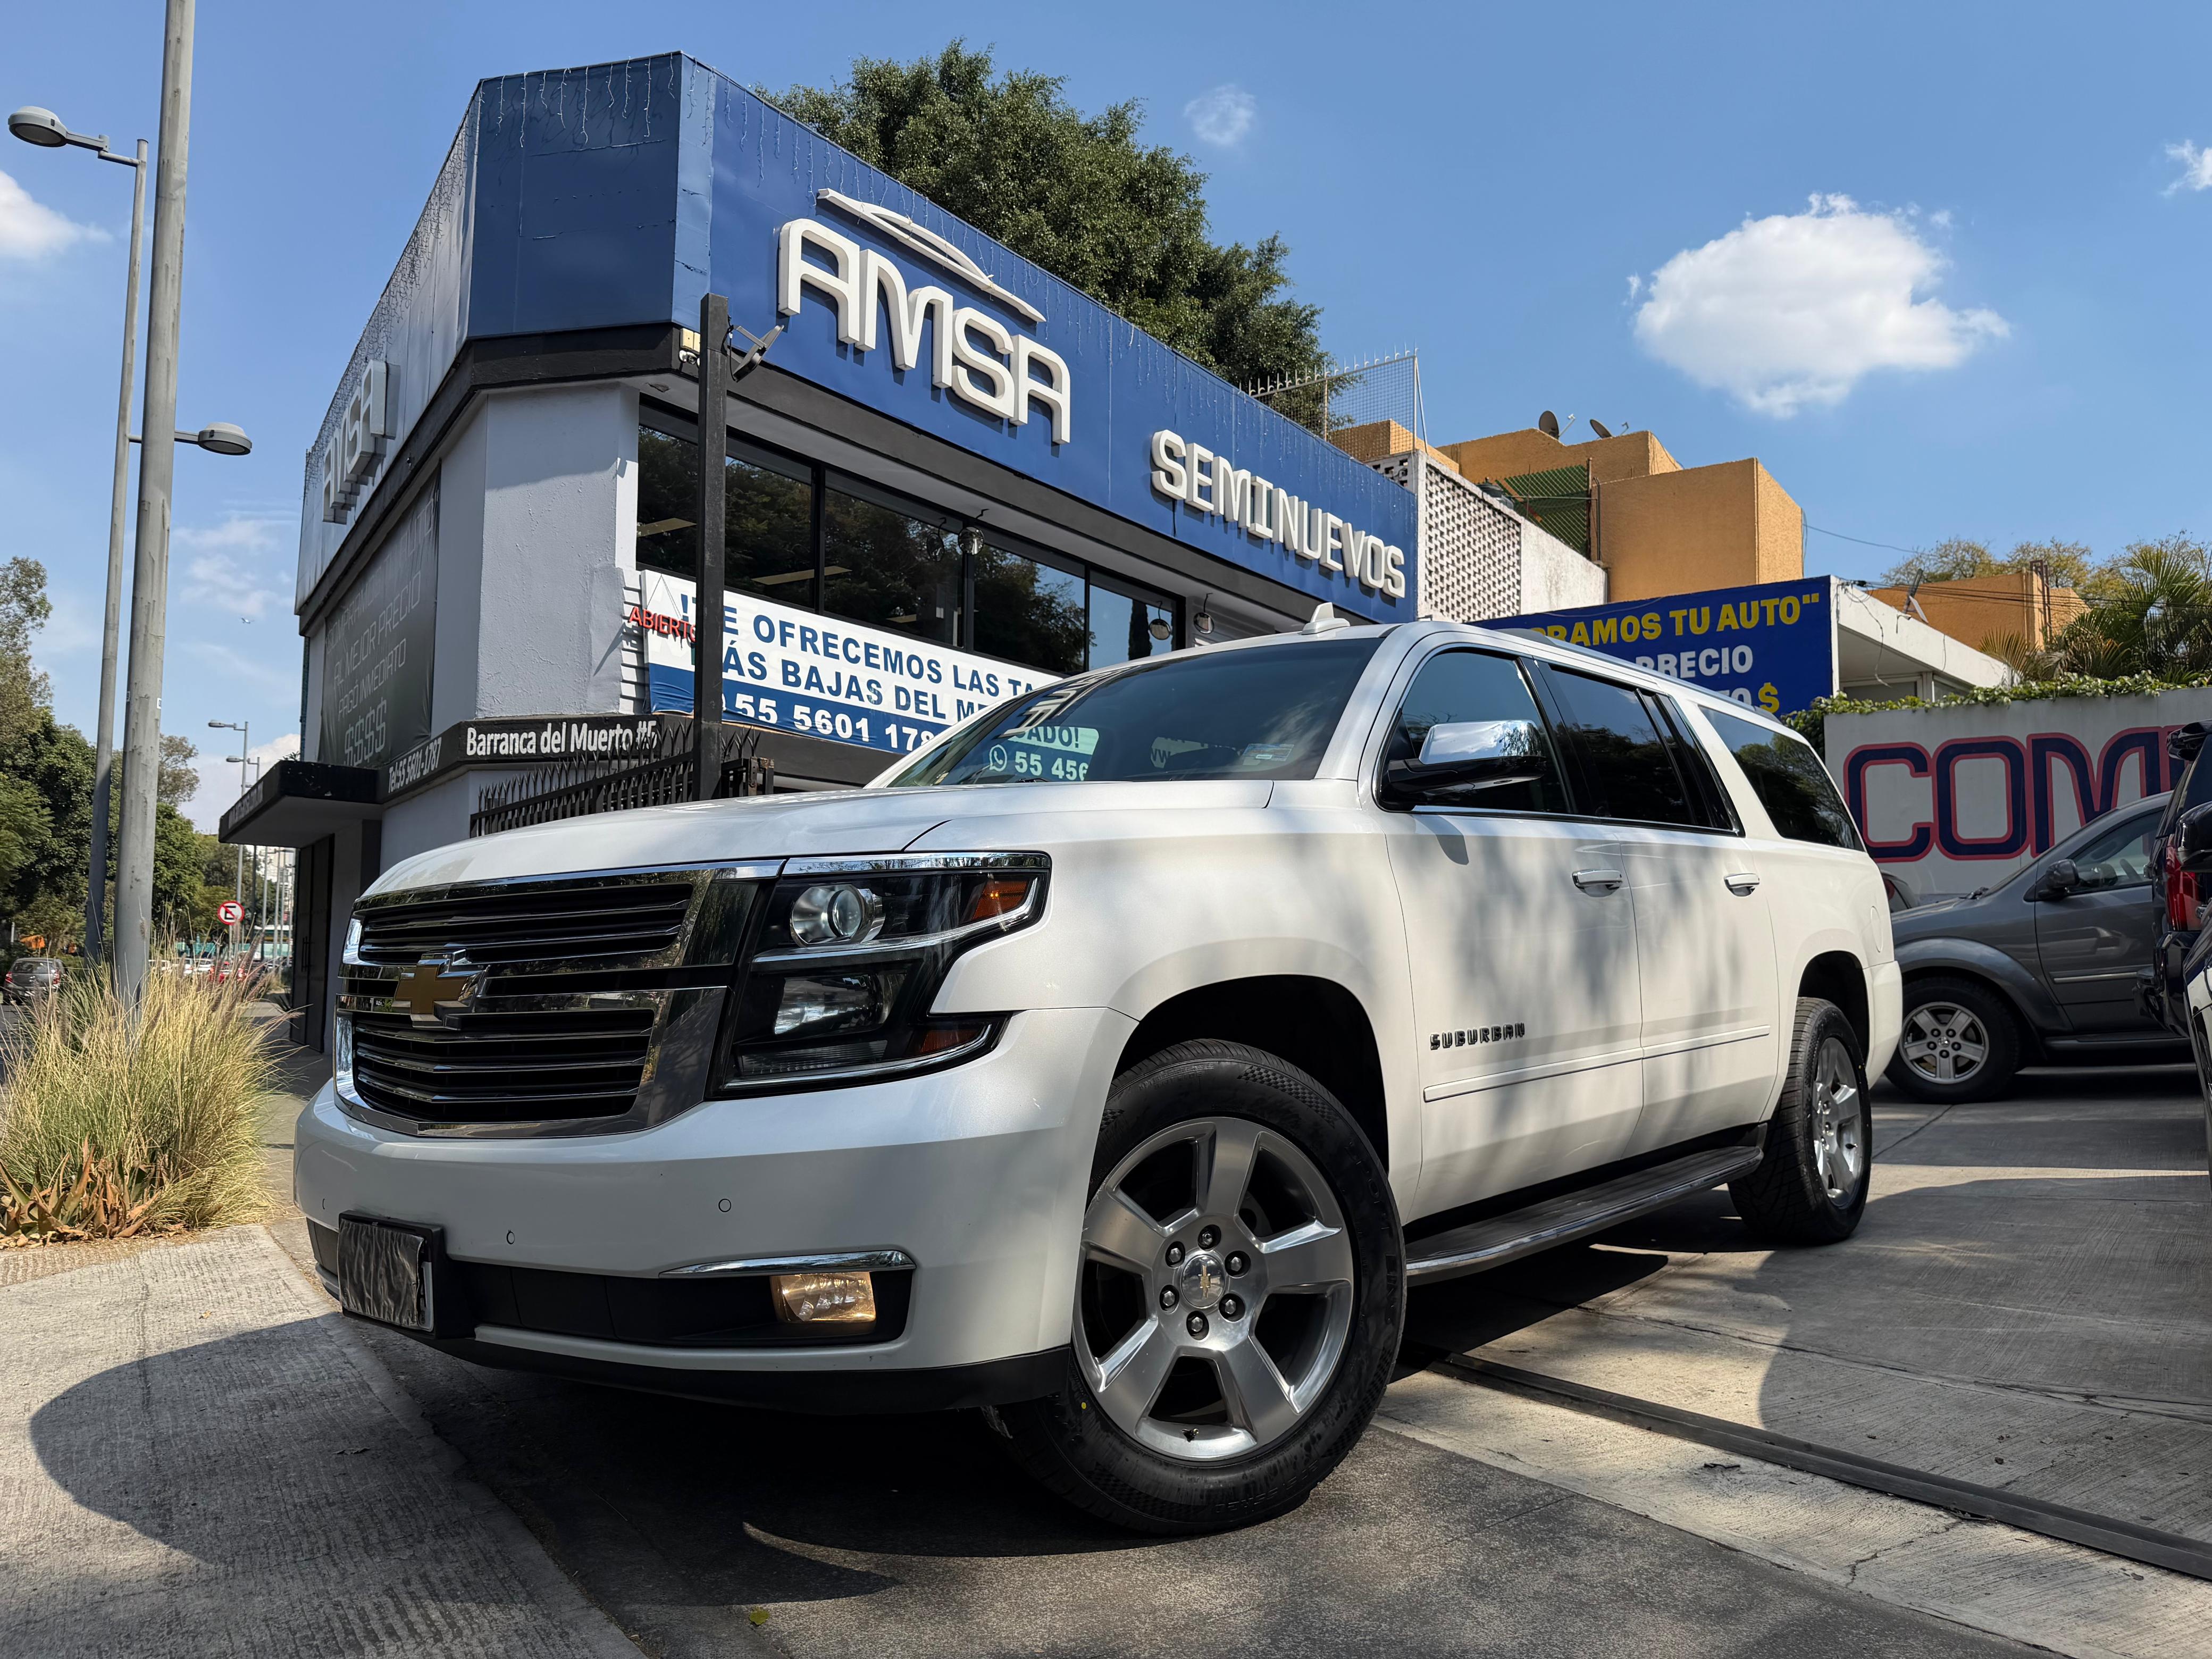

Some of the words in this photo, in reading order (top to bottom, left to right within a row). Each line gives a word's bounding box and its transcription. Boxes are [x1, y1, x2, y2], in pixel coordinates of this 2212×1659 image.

[778, 219, 1071, 445] AMSA
[1151, 429, 1405, 598] SEMINUEVOS
[345, 621, 376, 678] MEJOR
[378, 571, 421, 645] PRECIO
[1530, 613, 1662, 647] RAMOS
[1669, 606, 1710, 636] TU
[1716, 593, 1819, 632] AUTO"
[359, 638, 406, 704] INMEDIATO
[753, 615, 942, 684] OFRECEMOS
[953, 665, 1000, 697] LAS
[735, 693, 778, 725] 55
[793, 704, 870, 742] 5601
[782, 659, 883, 706] BAJAS
[895, 685, 946, 719] DEL
[405, 736, 442, 785] 5601-1787
[466, 727, 536, 756] Barranca
[540, 722, 567, 753] del
[571, 723, 633, 752] Muerto
[1015, 751, 1042, 776] 55
[1430, 1022, 1526, 1051] SUBURBAN
